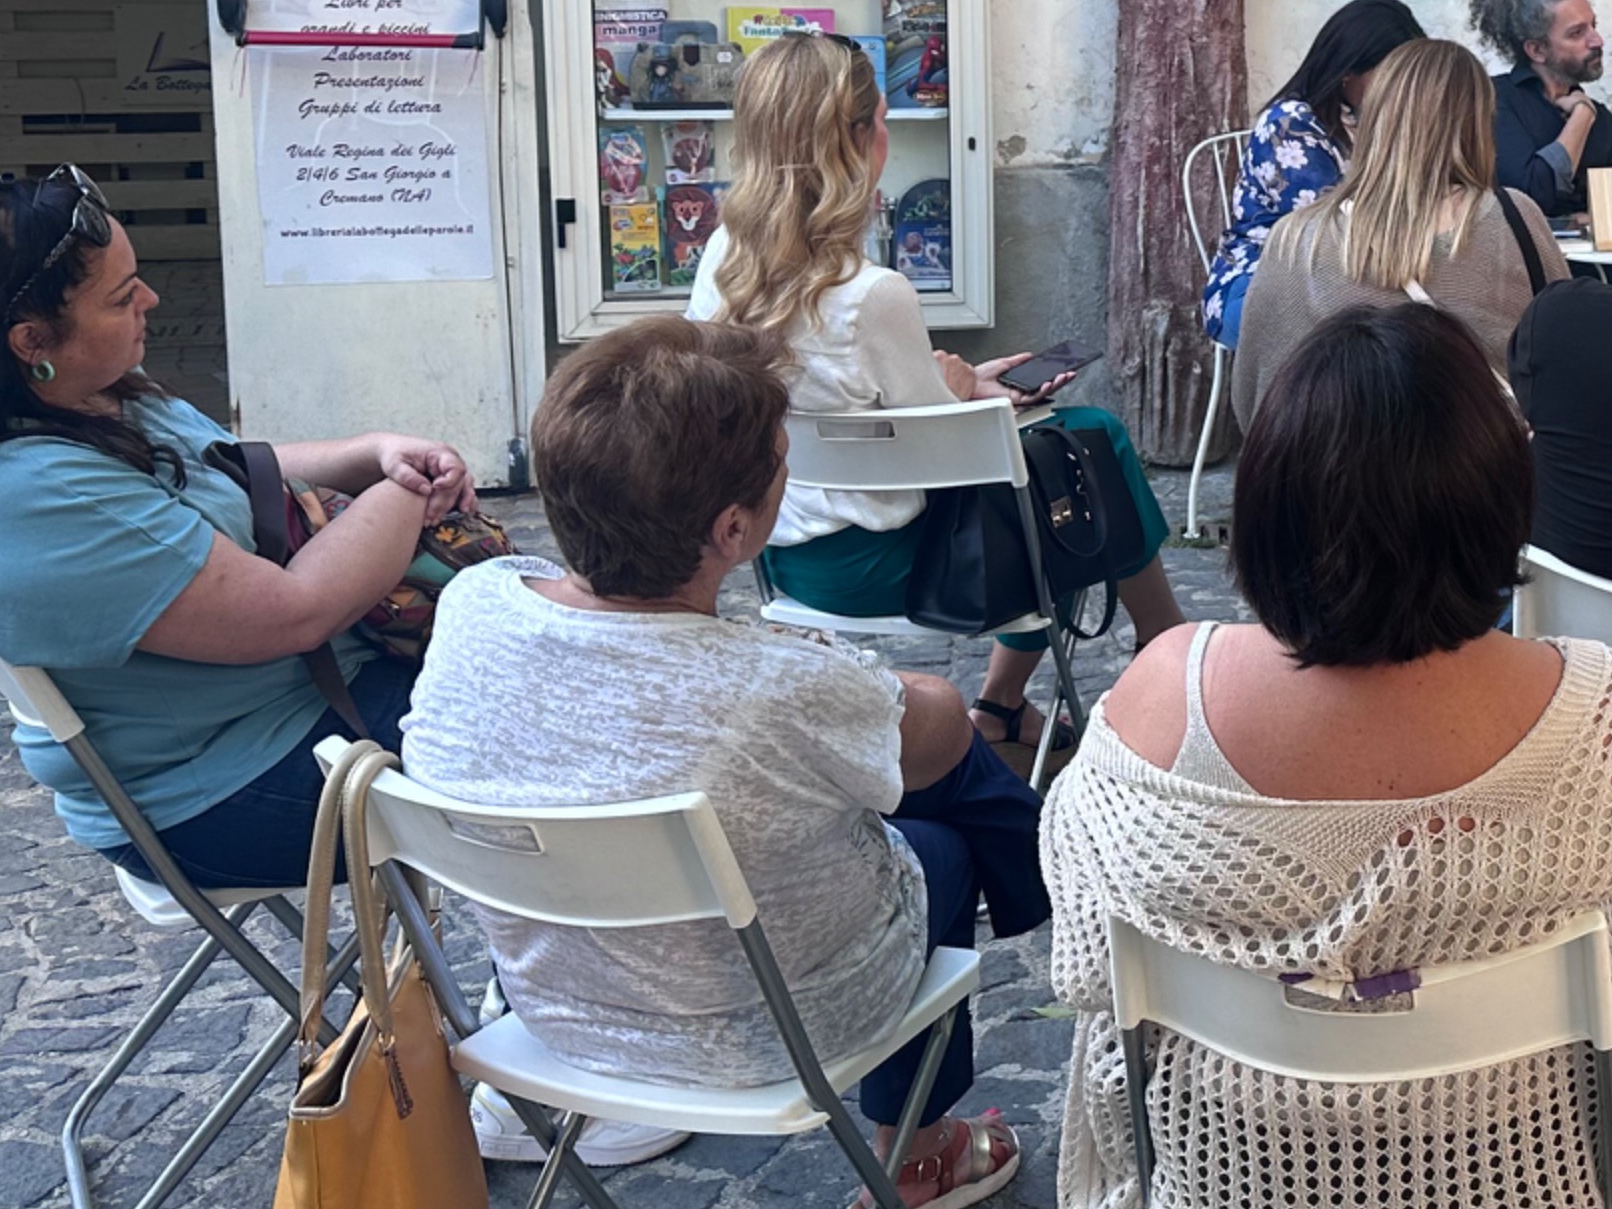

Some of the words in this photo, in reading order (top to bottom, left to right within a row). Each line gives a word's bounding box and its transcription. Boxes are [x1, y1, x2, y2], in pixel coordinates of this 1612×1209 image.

[602, 26, 657, 37] manga
[321, 45, 413, 62] Laboratori
[313, 72, 425, 92] Presentazioni
[298, 98, 358, 120] Gruppi
[364, 99, 381, 114] di
[387, 99, 442, 114] lettura
[286, 143, 326, 159] Viale
[333, 143, 385, 161] Regina
[390, 141, 414, 158] dei
[418, 141, 457, 160] Gigli
[345, 166, 378, 180] San
[384, 165, 437, 184] Giorgio
[441, 170, 452, 180] a
[319, 189, 384, 207] Cremano
[390, 187, 433, 203] (NA)
